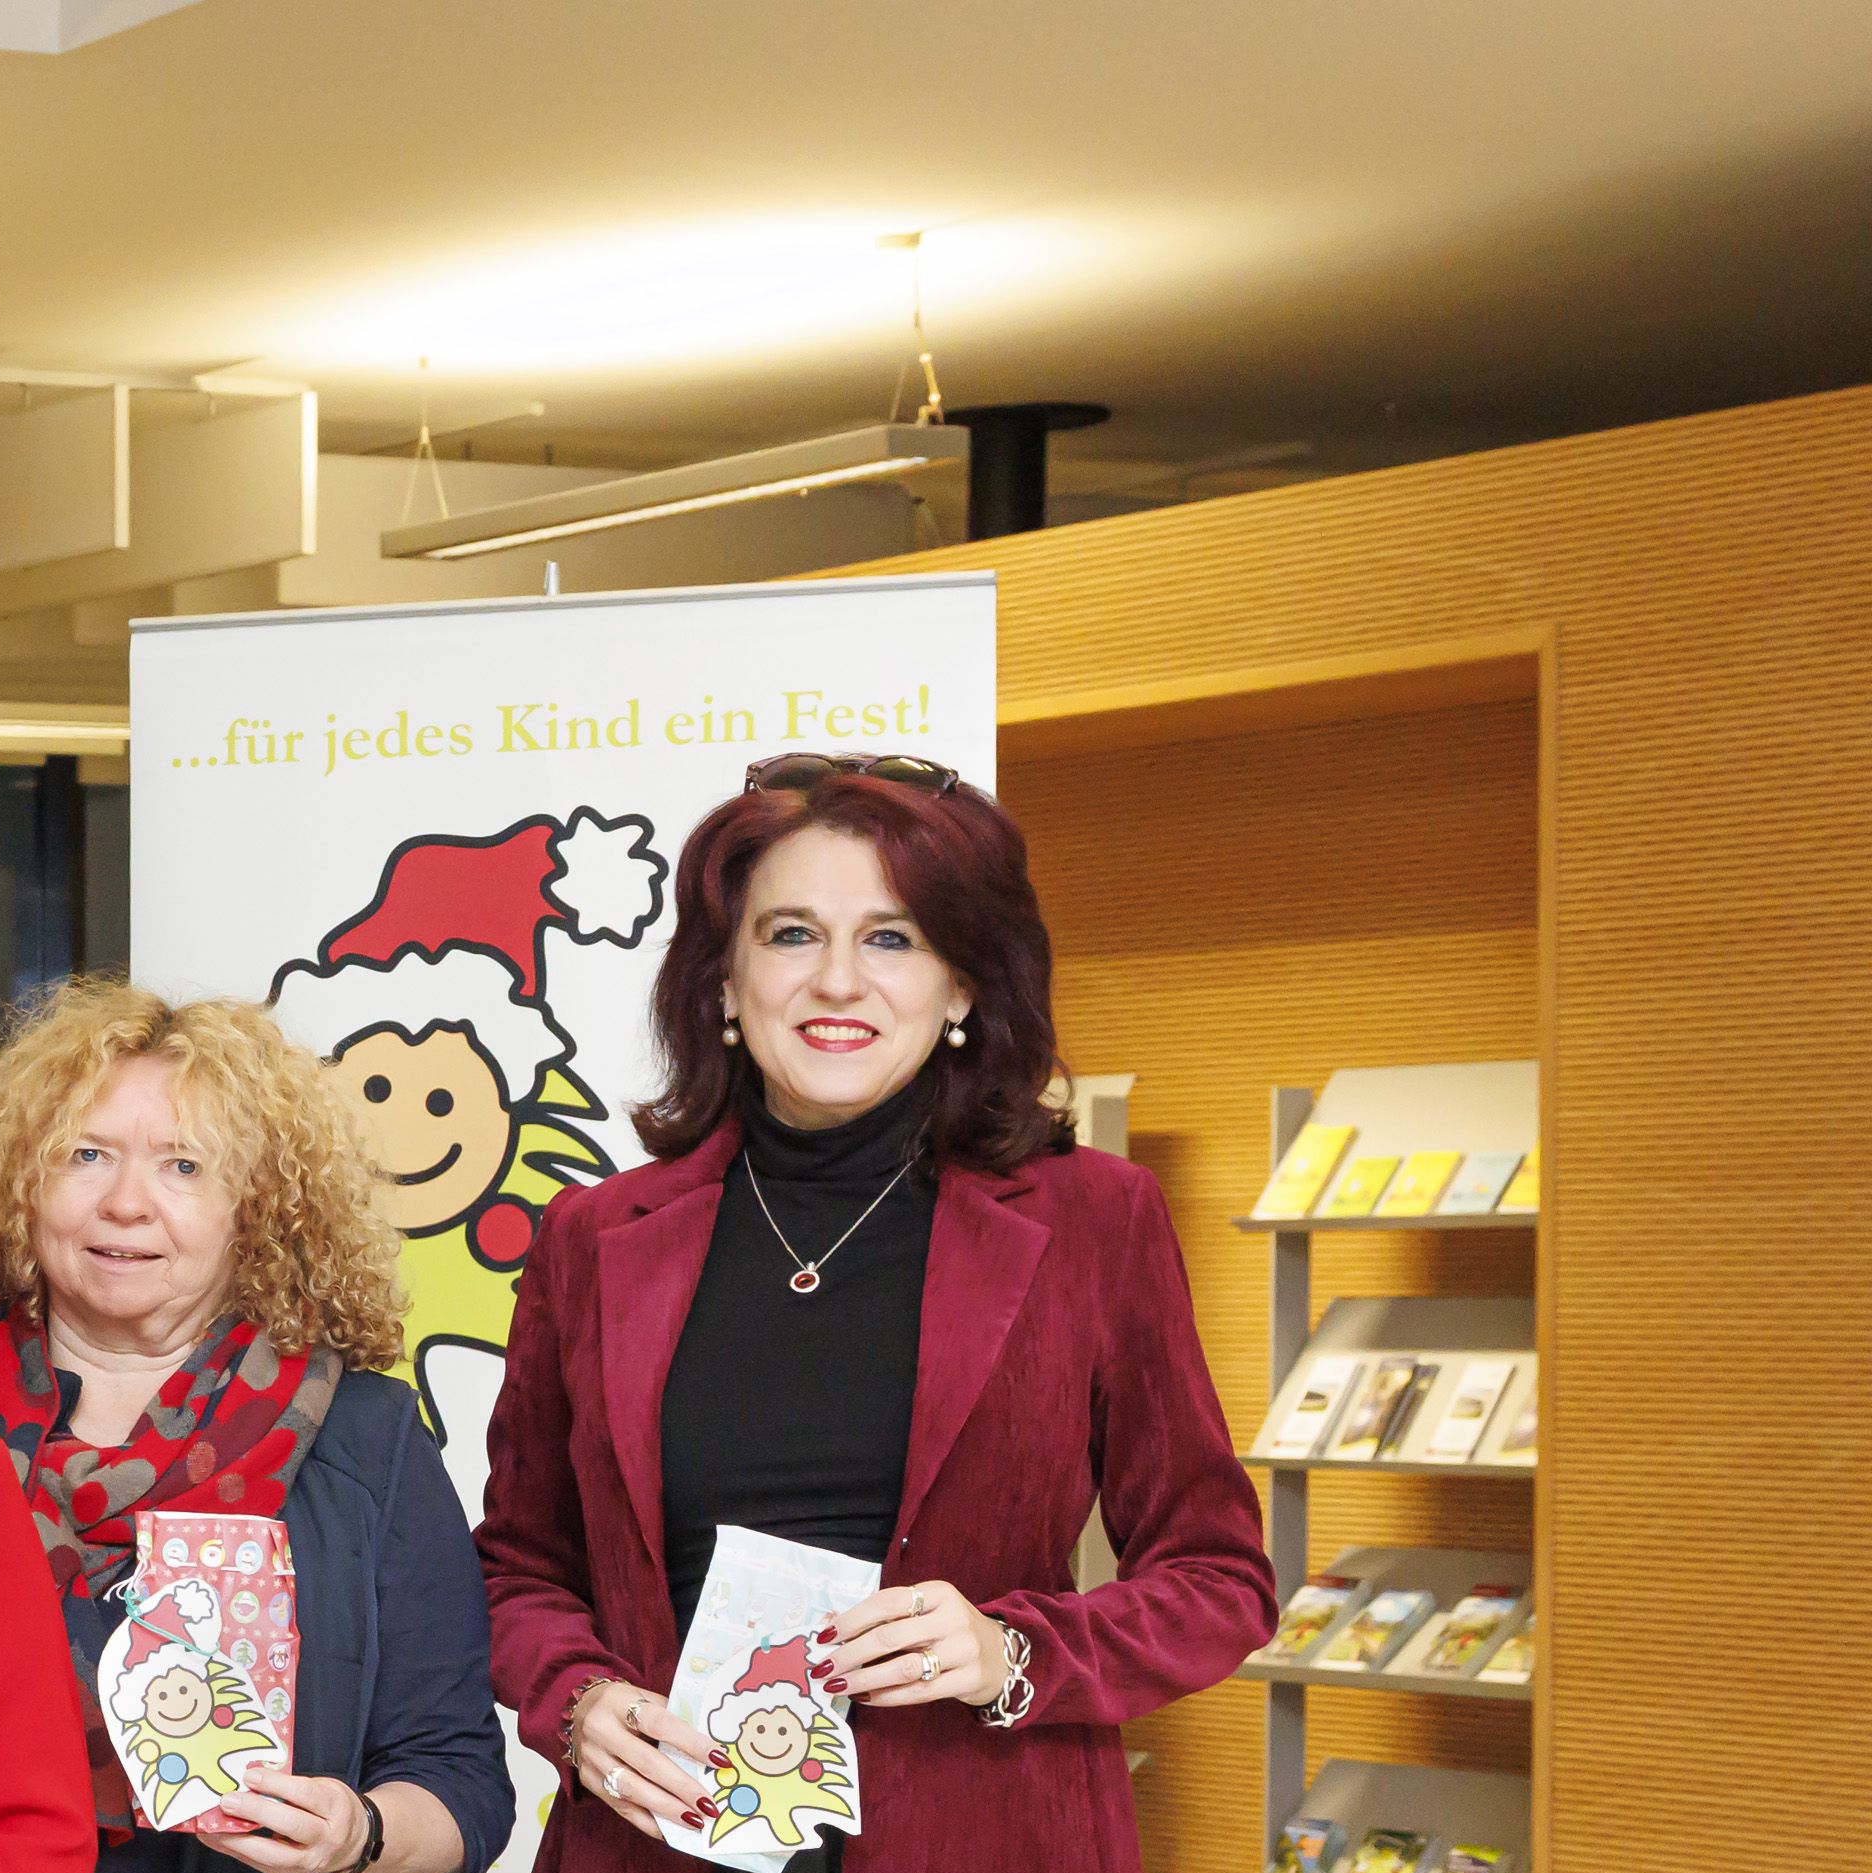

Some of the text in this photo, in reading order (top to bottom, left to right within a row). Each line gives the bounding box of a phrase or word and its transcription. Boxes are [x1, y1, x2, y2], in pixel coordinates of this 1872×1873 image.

[171, 683, 930, 777] ...für jedes Kind ein Fest!
